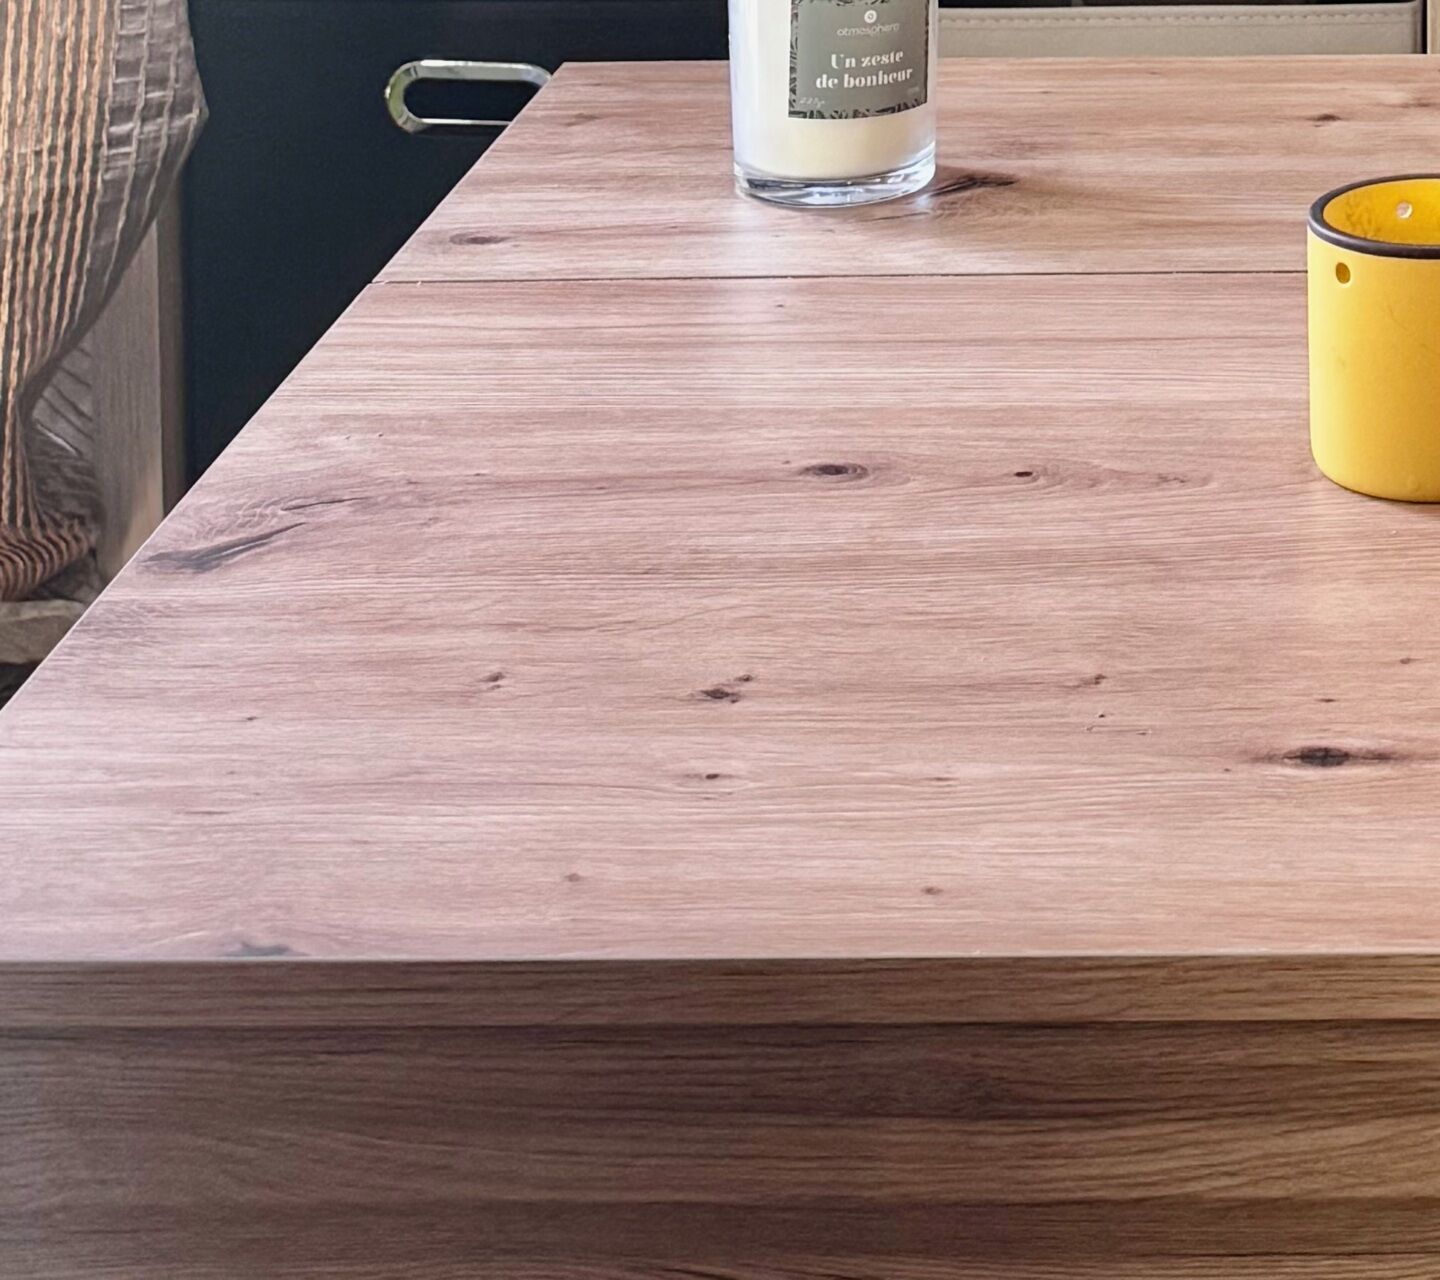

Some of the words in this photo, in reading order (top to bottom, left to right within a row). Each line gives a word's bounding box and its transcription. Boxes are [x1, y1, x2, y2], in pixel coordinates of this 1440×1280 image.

[831, 53, 856, 69] Un
[861, 50, 904, 68] zeste
[815, 73, 838, 89] de
[843, 68, 913, 89] bonheur
